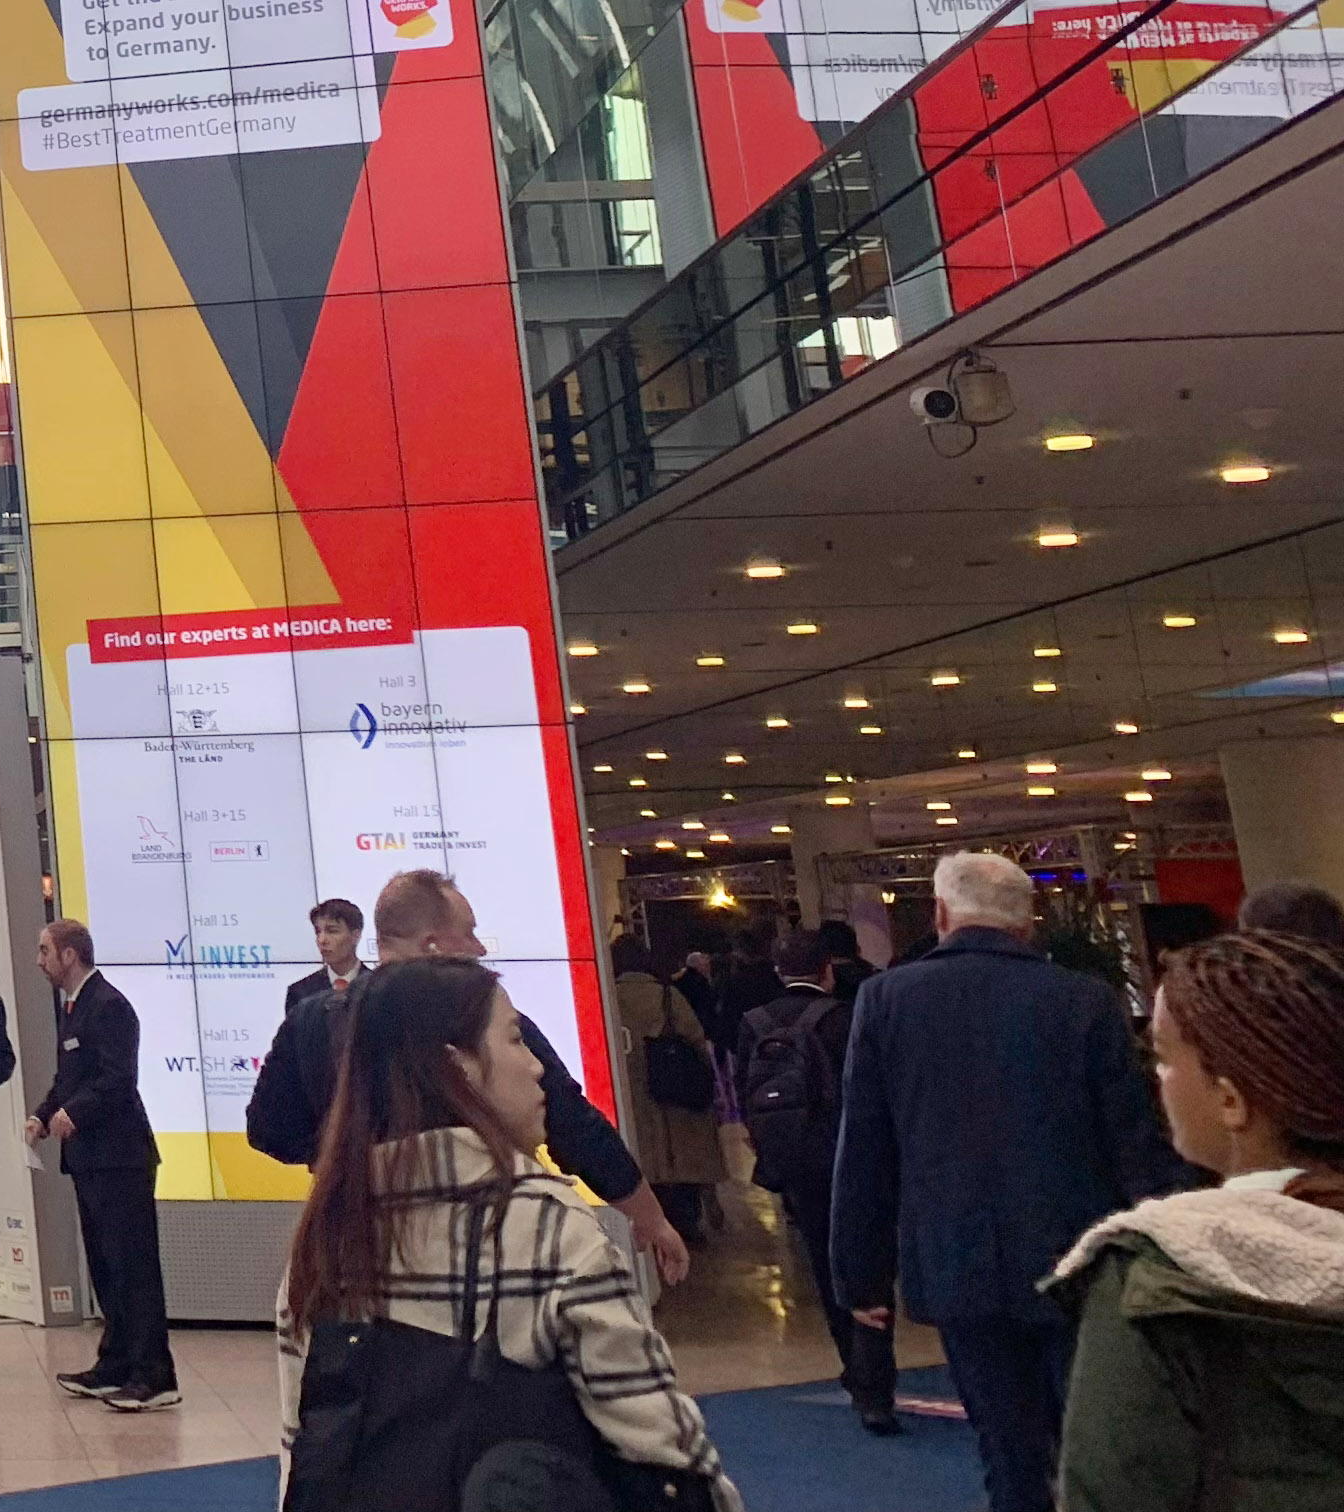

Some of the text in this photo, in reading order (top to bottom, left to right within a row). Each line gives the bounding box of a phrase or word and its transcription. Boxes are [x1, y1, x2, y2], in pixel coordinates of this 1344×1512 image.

[85, 12, 165, 37] Expand
[170, 9, 220, 31] your
[86, 36, 216, 61] to Germany.
[39, 80, 341, 128] germanyworks.com/medica
[42, 114, 297, 150] #BestTreatmentGermany
[104, 616, 392, 649] Find our experts at MEDICA here:
[157, 682, 230, 696] Hall 12+15
[378, 675, 417, 689] Hall 3
[381, 701, 443, 720] bayern
[383, 718, 468, 736] innovativ
[184, 810, 208, 822] Hall
[393, 805, 440, 818] Hall 15
[193, 914, 239, 927] Hall 15
[200, 945, 272, 969] INVEST
[204, 1029, 250, 1041] Hall 15
